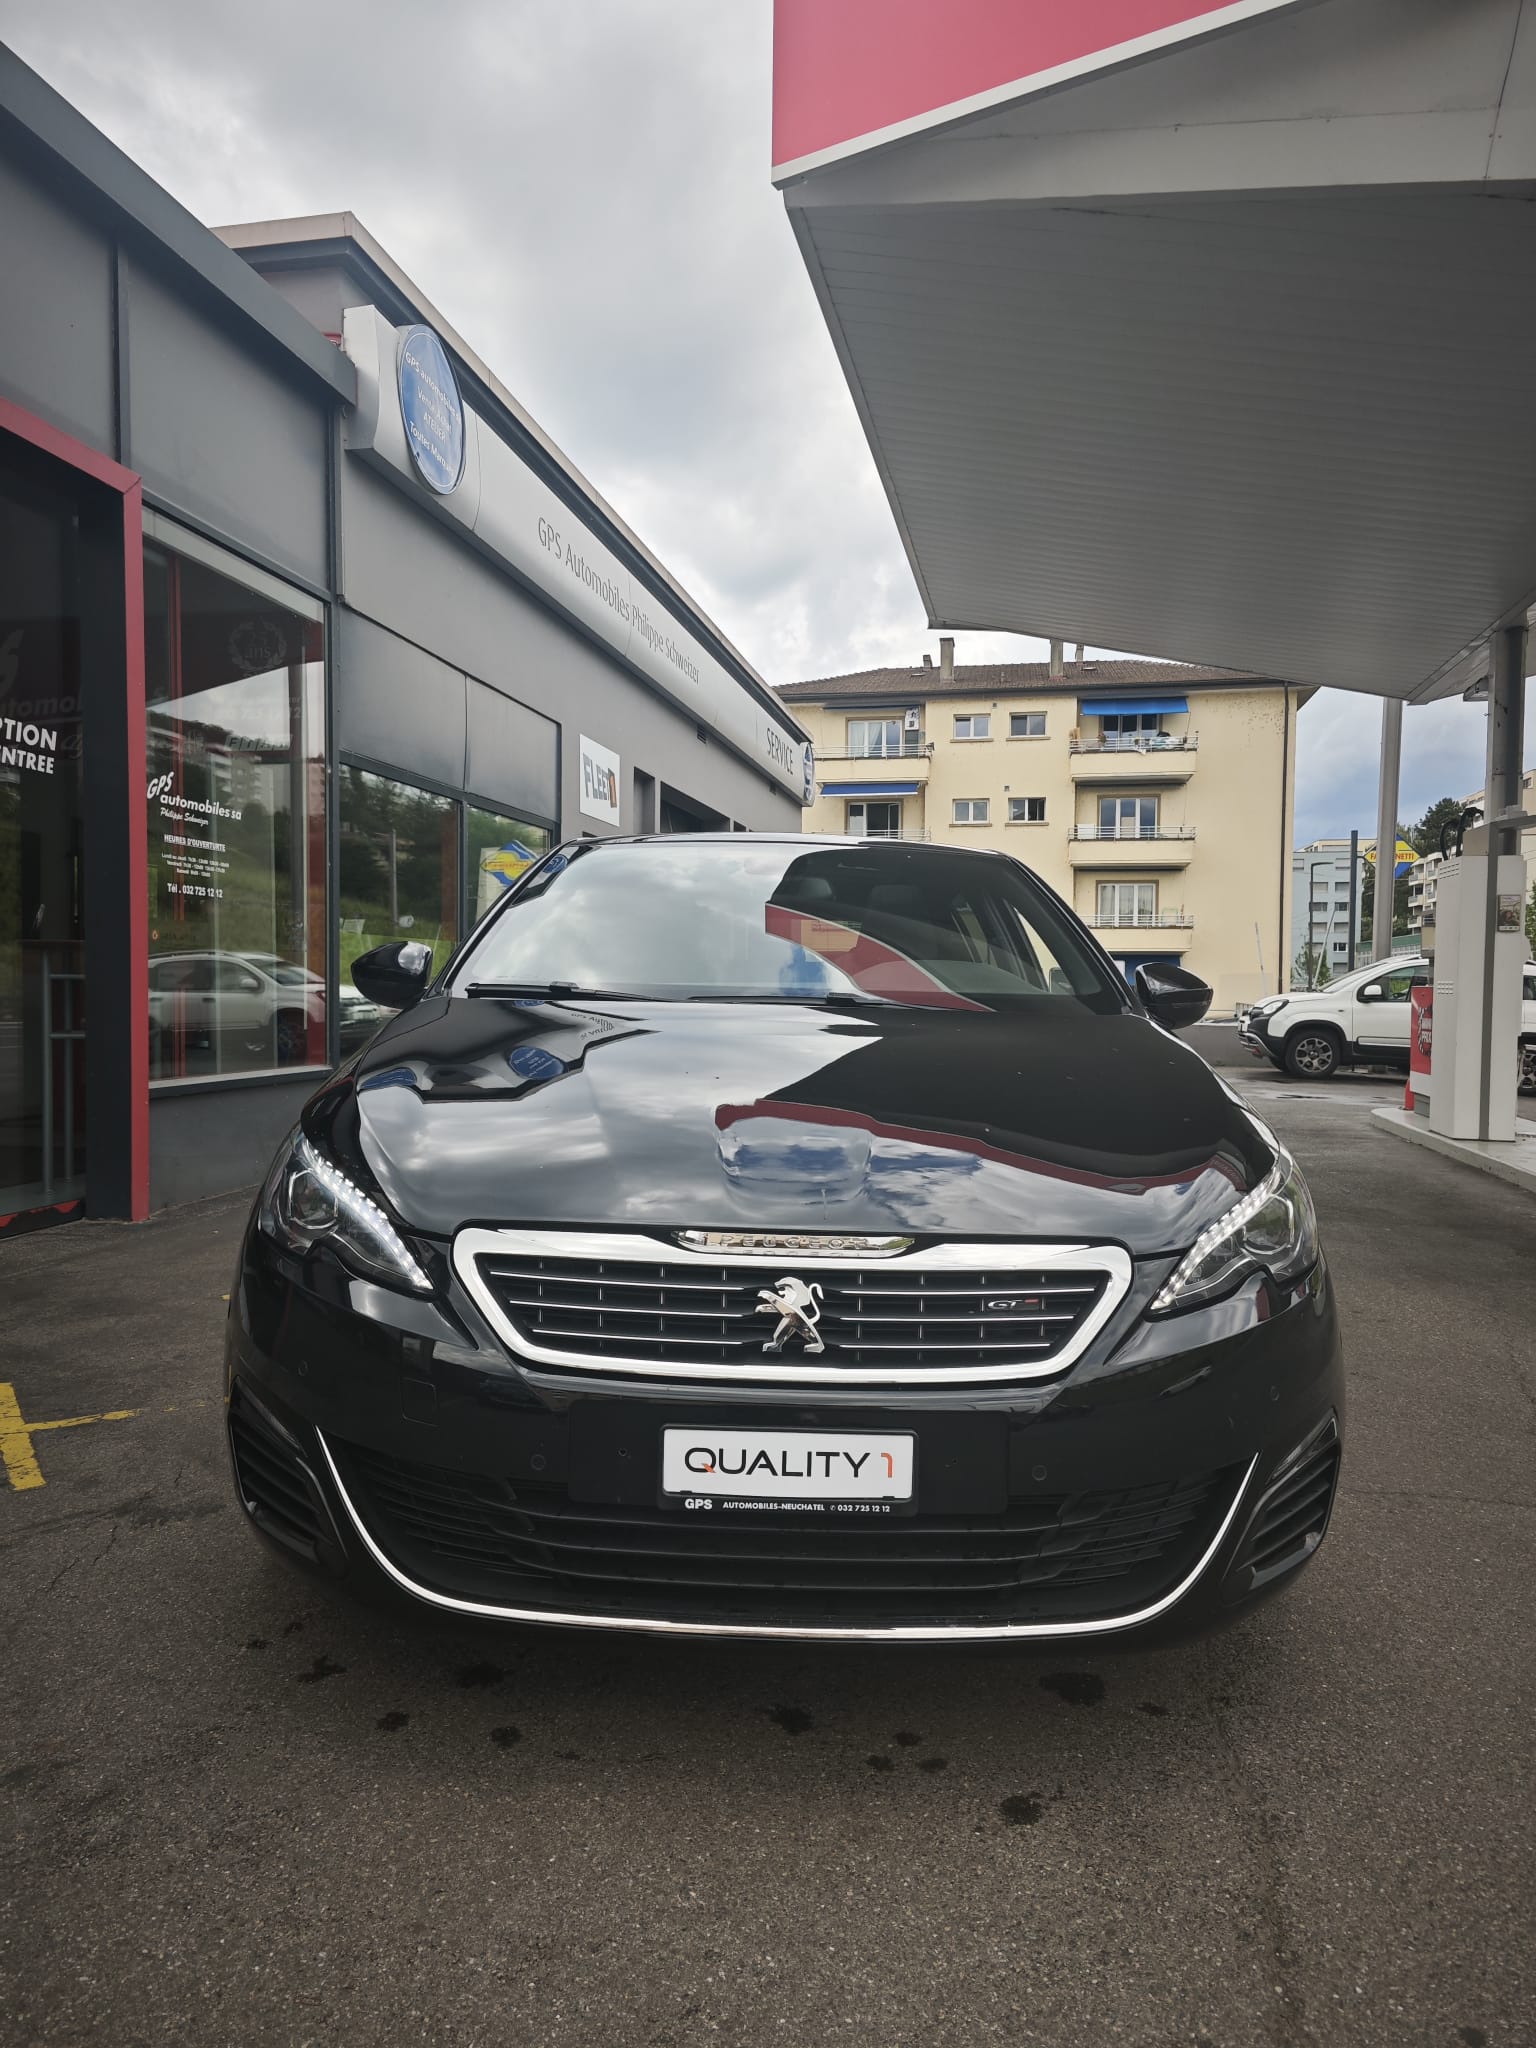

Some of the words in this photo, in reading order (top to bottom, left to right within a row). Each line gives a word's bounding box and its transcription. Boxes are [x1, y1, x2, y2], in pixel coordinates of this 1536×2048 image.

[405, 351, 420, 373] GPS
[409, 420, 431, 450] Toutes
[538, 517, 562, 560] GPS
[565, 543, 630, 622] Automobiles
[632, 604, 664, 654] Philippe
[665, 637, 700, 686] Schweizer
[0, 717, 57, 751] TION
[0, 744, 55, 775] NTREE
[766, 727, 794, 776] SERVICE
[147, 771, 175, 799] GPS
[160, 794, 230, 818] automobiles
[230, 809, 242, 820] sa
[164, 833, 187, 846] HEURES
[182, 884, 194, 895] 032
[195, 886, 207, 897] 725
[207, 887, 215, 898] 12
[215, 888, 224, 899] 12
[684, 1498, 713, 1510] GPS
[837, 1504, 854, 1512] 032
[854, 1504, 870, 1513] 725
[871, 1505, 881, 1513] 12
[882, 1505, 891, 1513] 12
